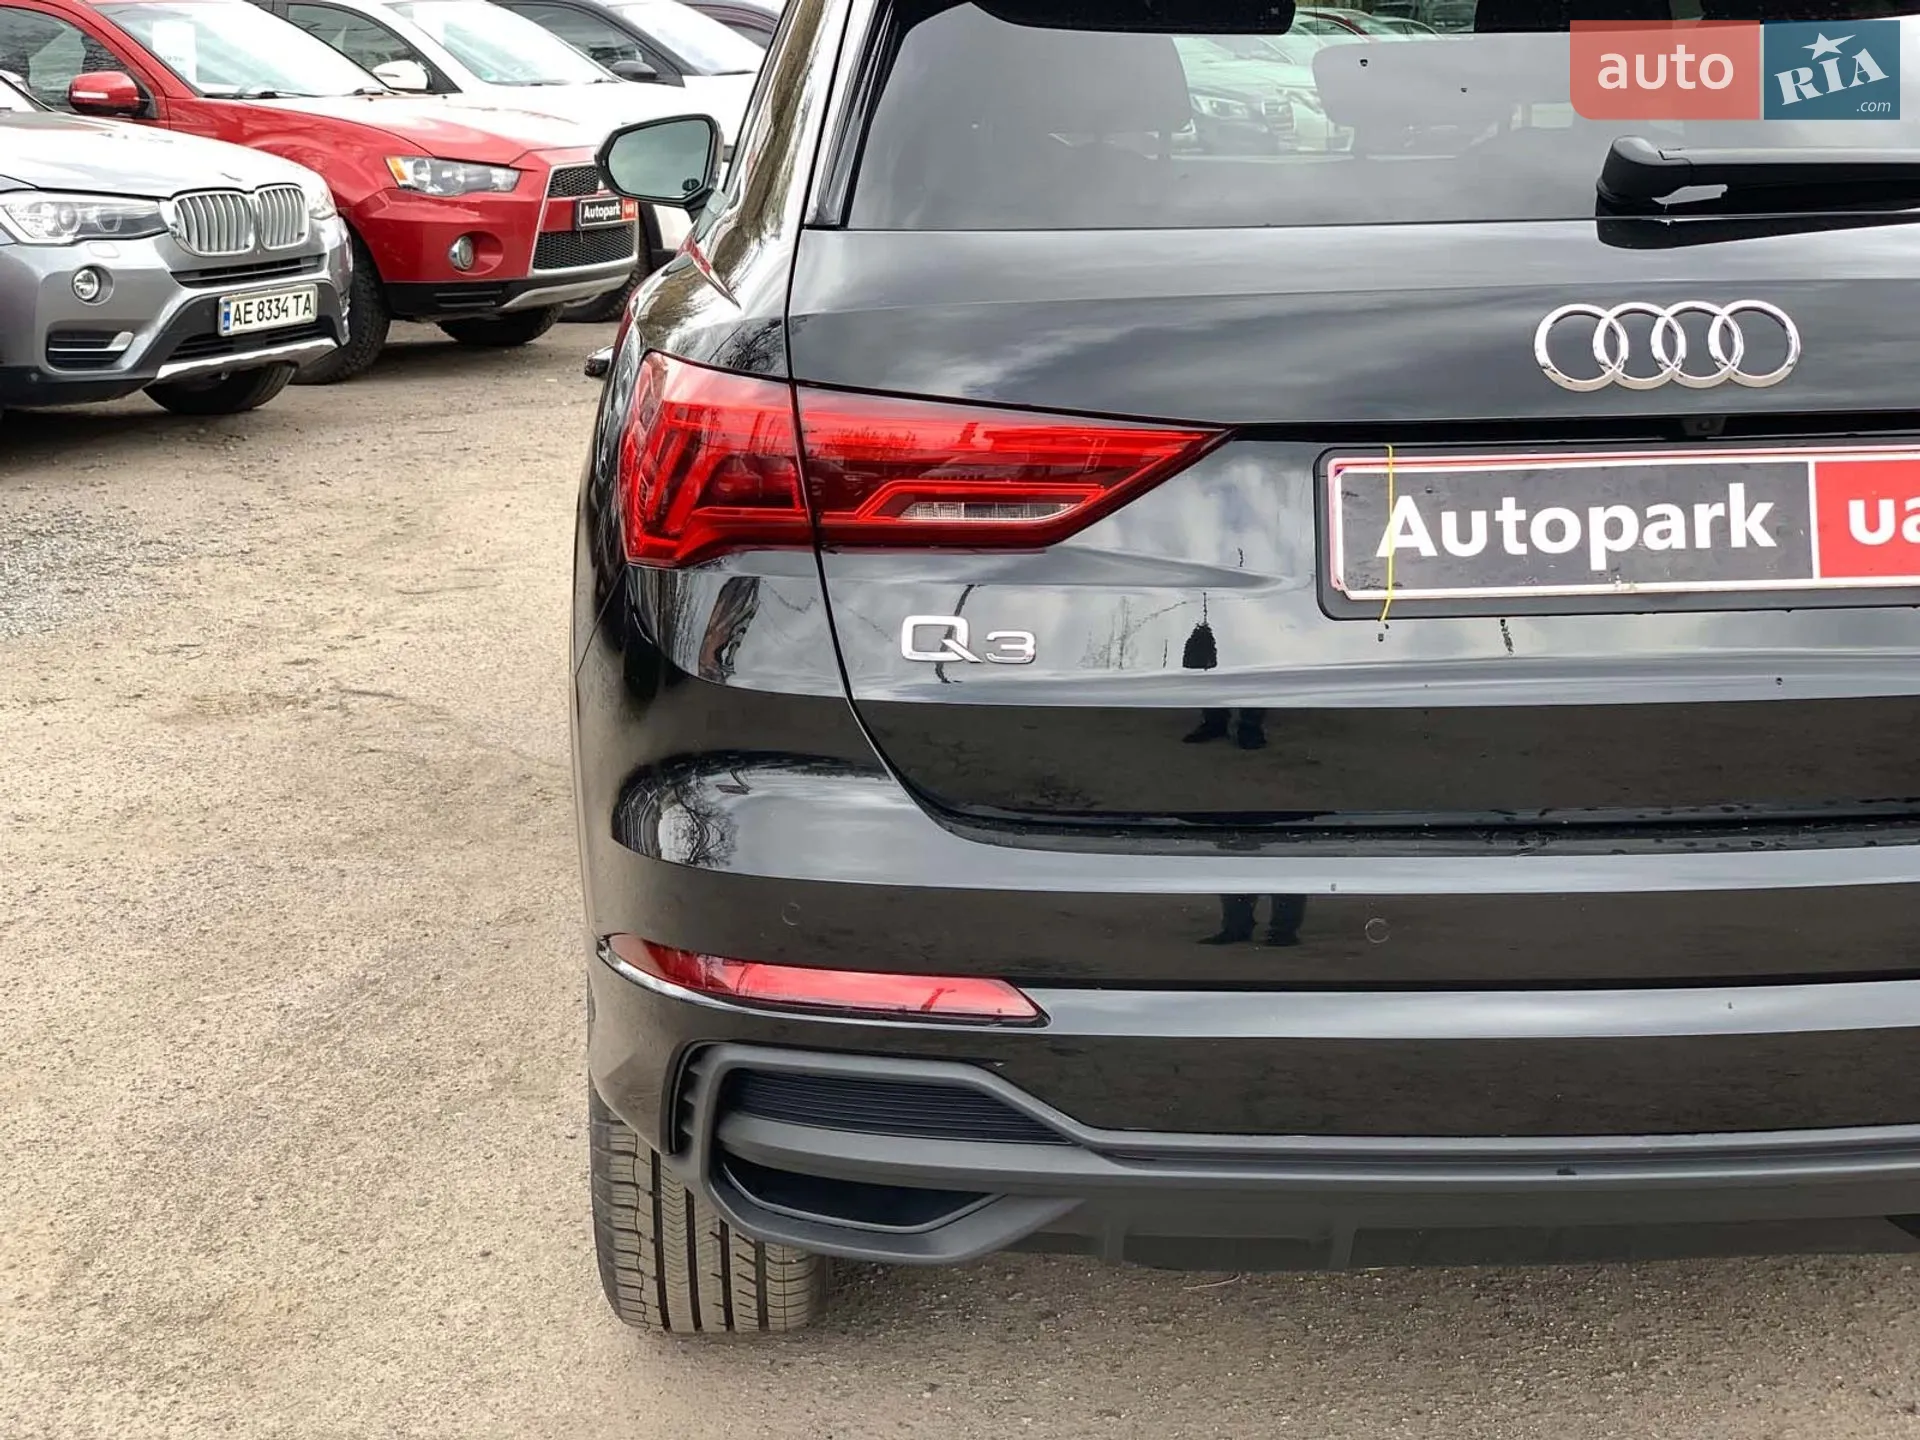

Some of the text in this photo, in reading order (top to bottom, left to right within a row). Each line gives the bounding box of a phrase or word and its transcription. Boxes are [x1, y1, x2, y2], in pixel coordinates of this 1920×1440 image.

[584, 202, 620, 220] Autopark
[233, 293, 312, 326] AE 8334 TA
[1376, 482, 1777, 571] Autopark
[901, 615, 1036, 664] Q3
